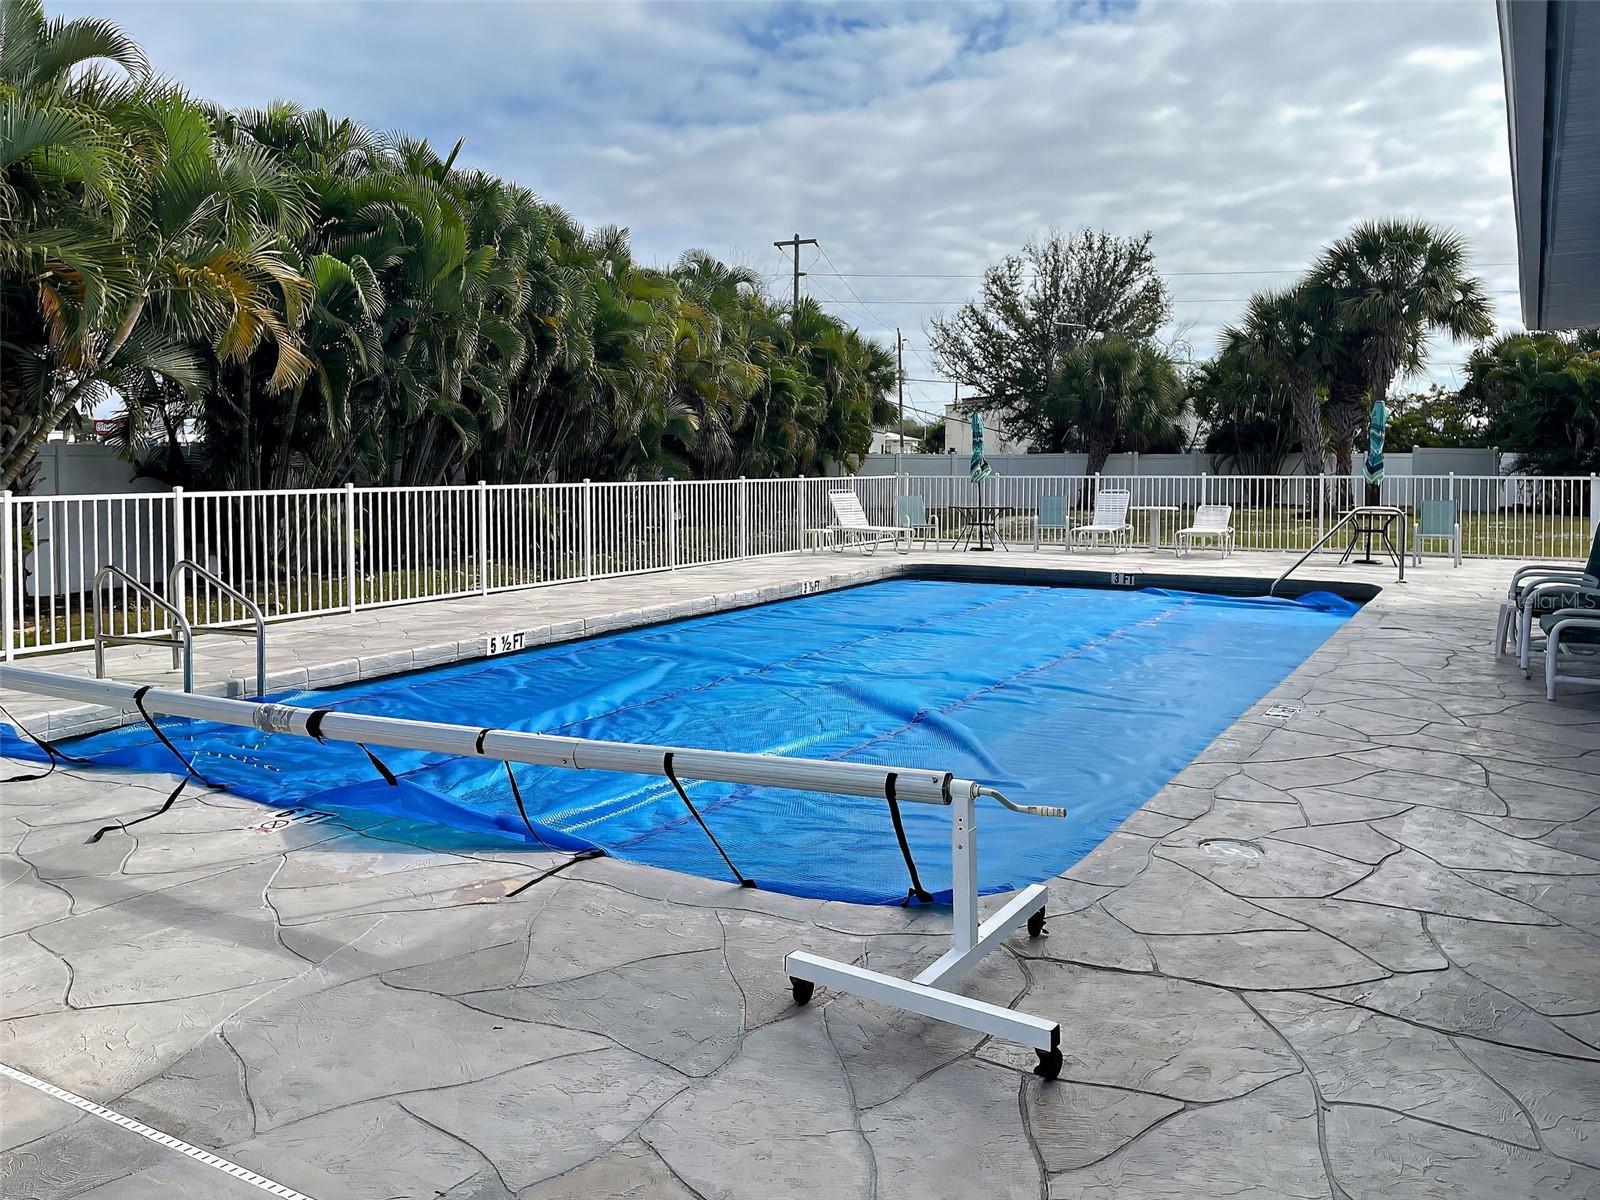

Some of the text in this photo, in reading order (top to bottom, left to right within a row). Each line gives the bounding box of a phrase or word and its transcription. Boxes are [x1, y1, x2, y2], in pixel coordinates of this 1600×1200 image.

[1114, 573, 1134, 584] 3 FT
[490, 637, 497, 654] 5
[513, 632, 525, 650] FT
[291, 811, 337, 824] FT
